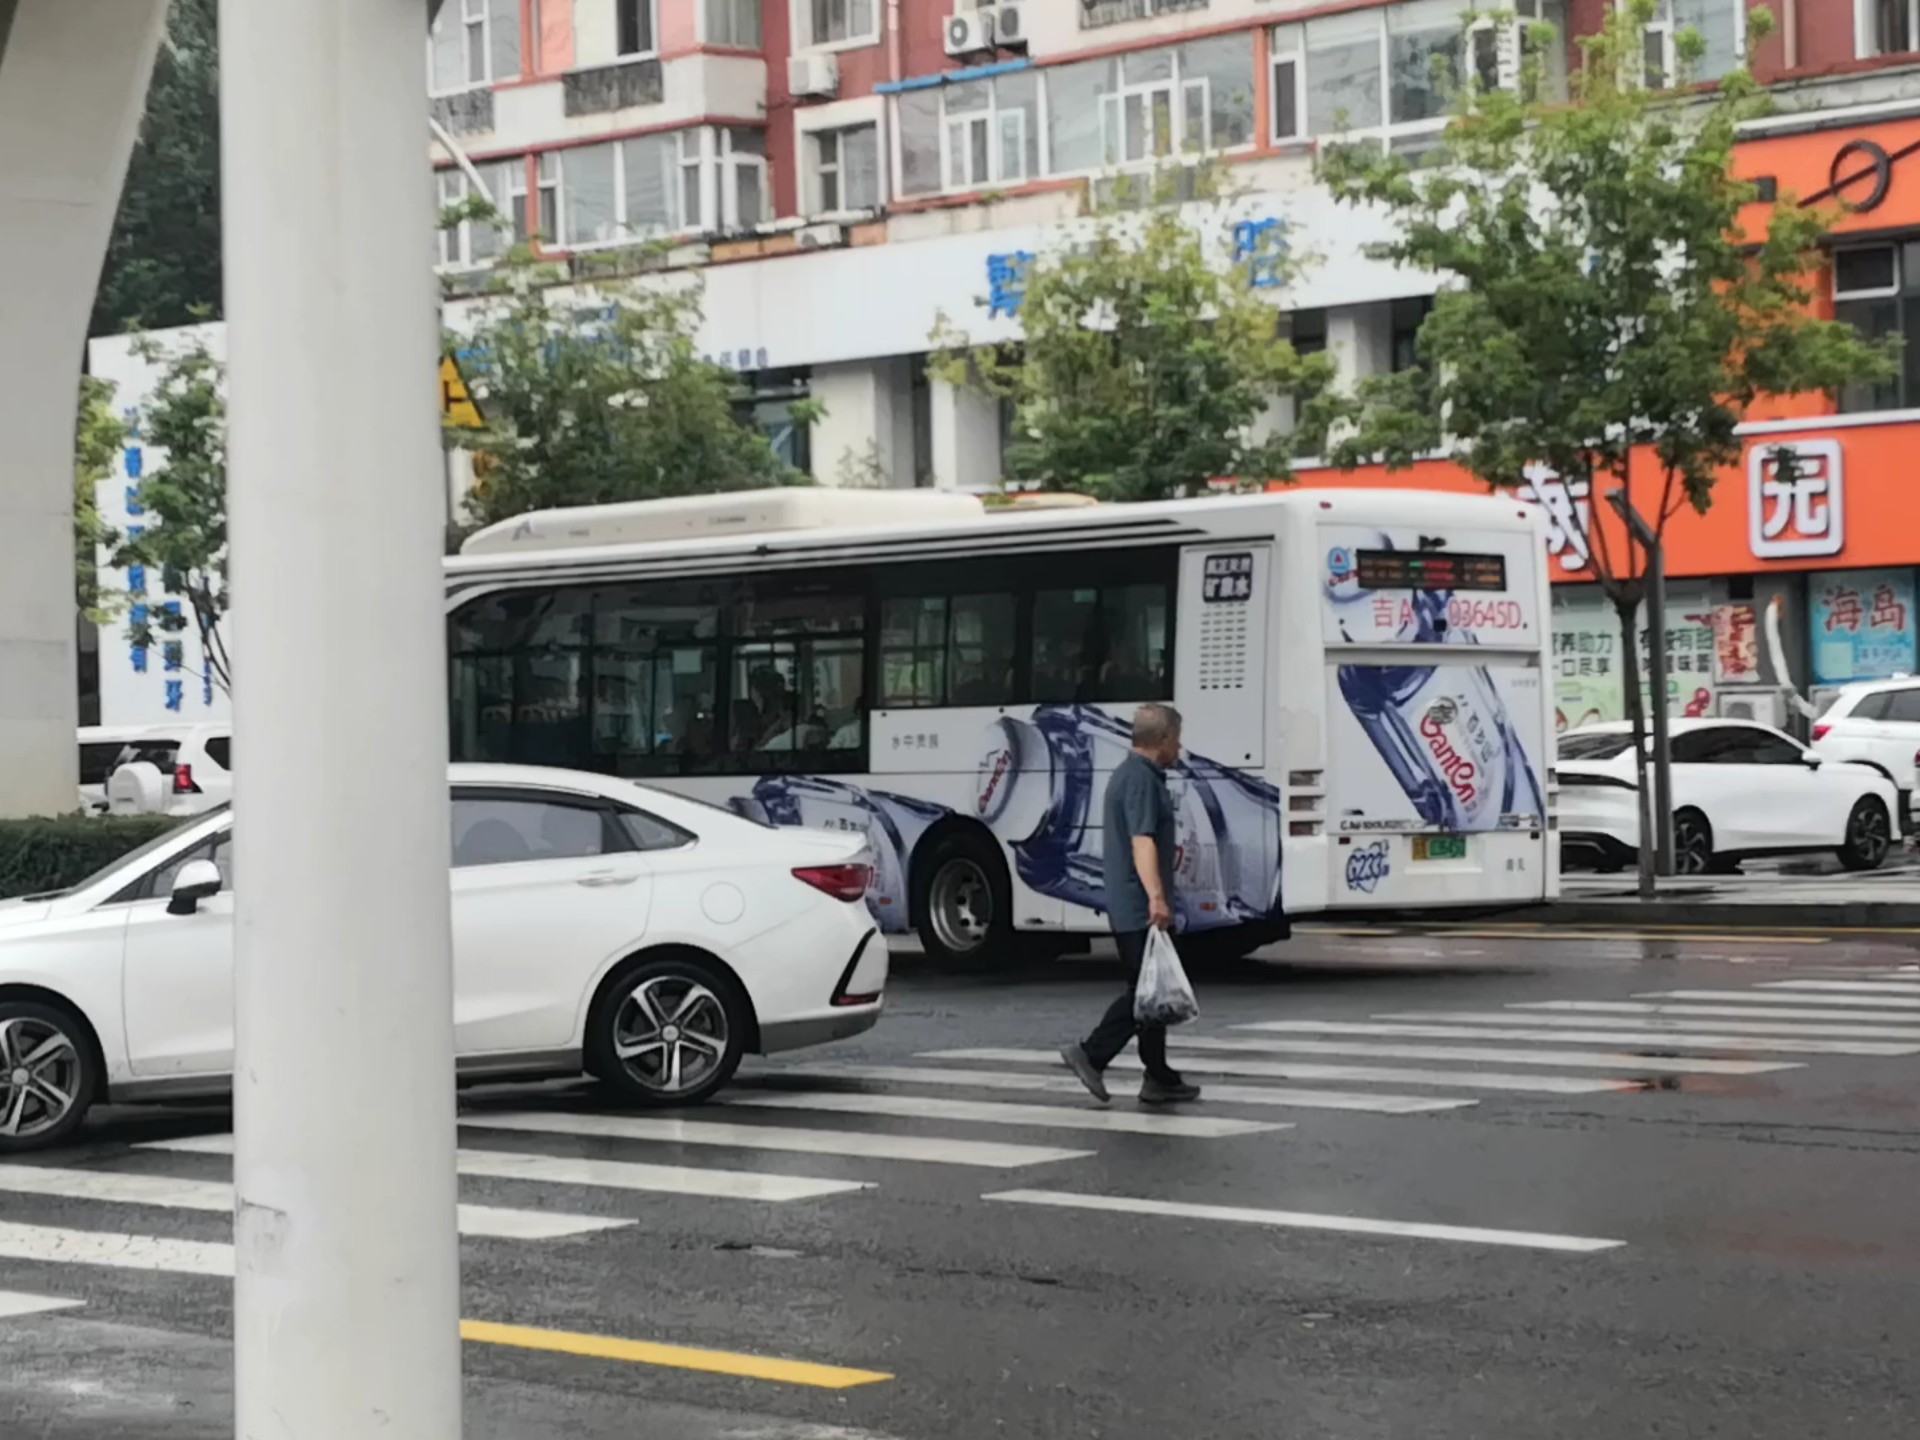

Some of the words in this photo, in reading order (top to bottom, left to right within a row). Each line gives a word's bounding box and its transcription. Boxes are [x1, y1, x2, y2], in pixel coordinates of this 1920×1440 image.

[1372, 599, 1414, 627] 吉A
[1449, 600, 1521, 629] 03645D
[1822, 585, 1906, 632] 海岛
